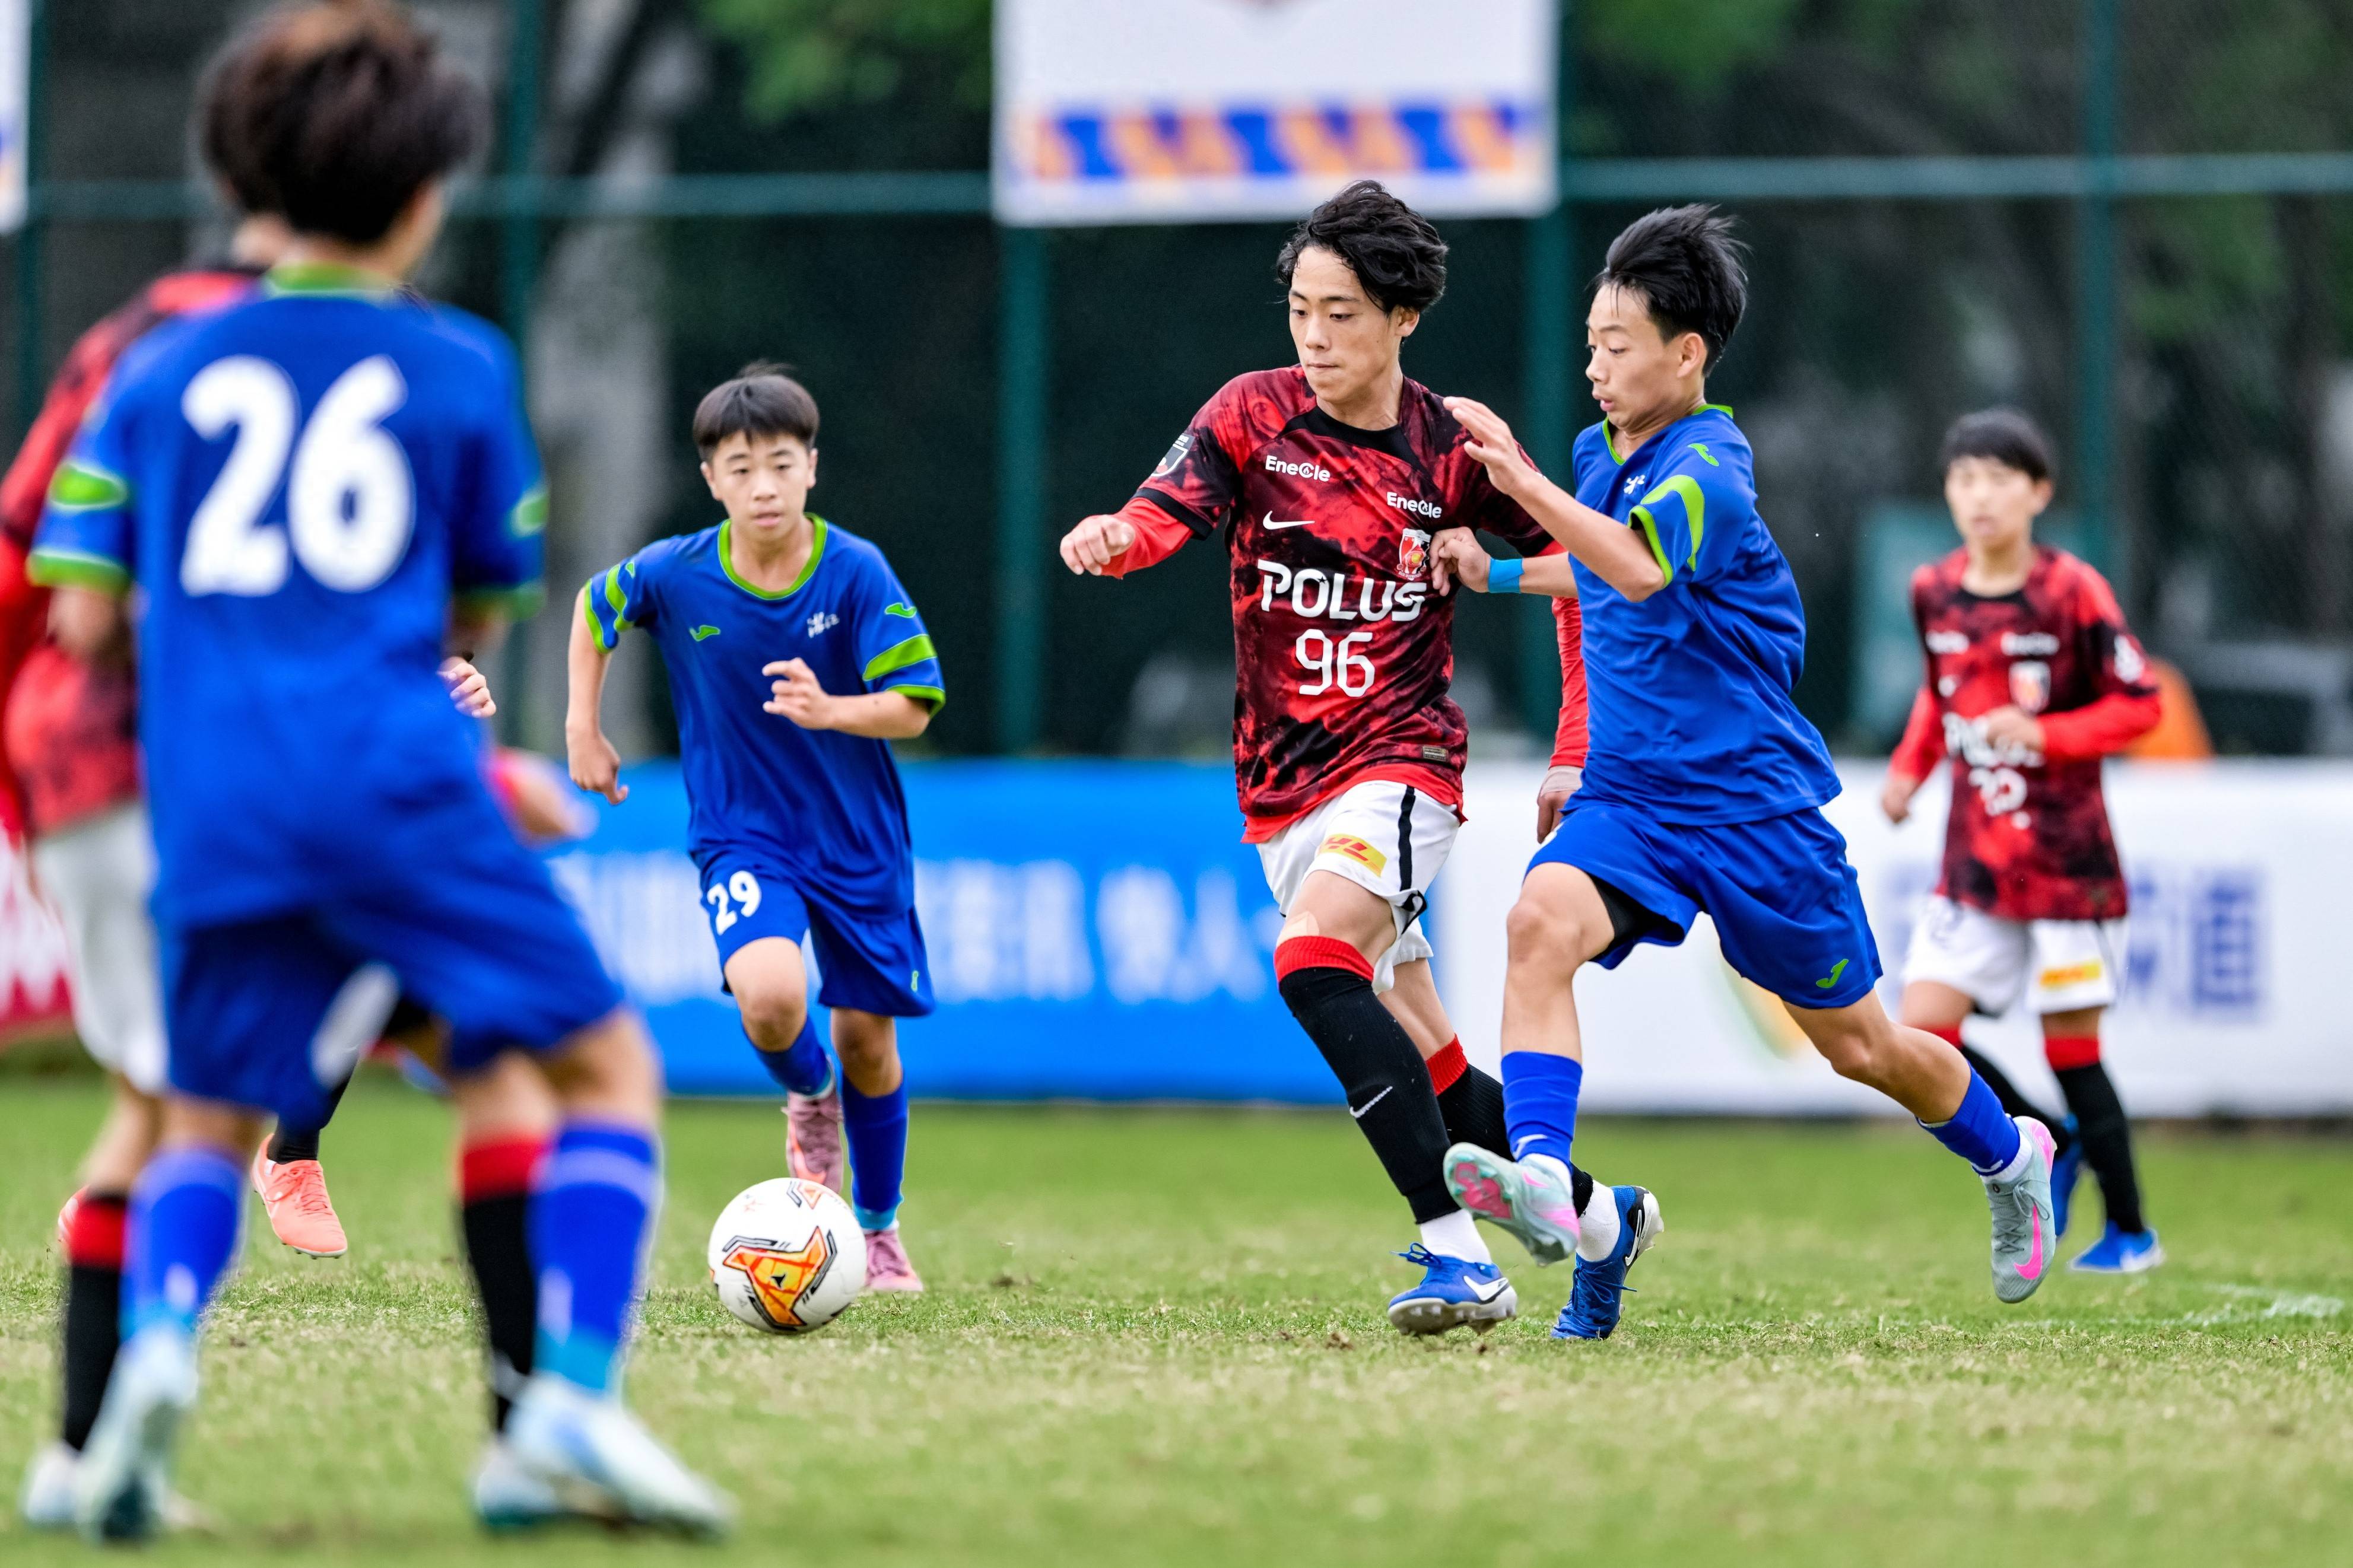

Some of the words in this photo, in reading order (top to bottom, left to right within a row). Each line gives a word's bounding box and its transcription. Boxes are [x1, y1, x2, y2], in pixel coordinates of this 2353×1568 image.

[180, 356, 413, 596] 26
[1265, 454, 1331, 482] EneCle
[1386, 491, 1443, 519] EneCle
[1257, 559, 1427, 622] POLUS
[1295, 628, 1376, 698] 96
[707, 870, 762, 936] 29
